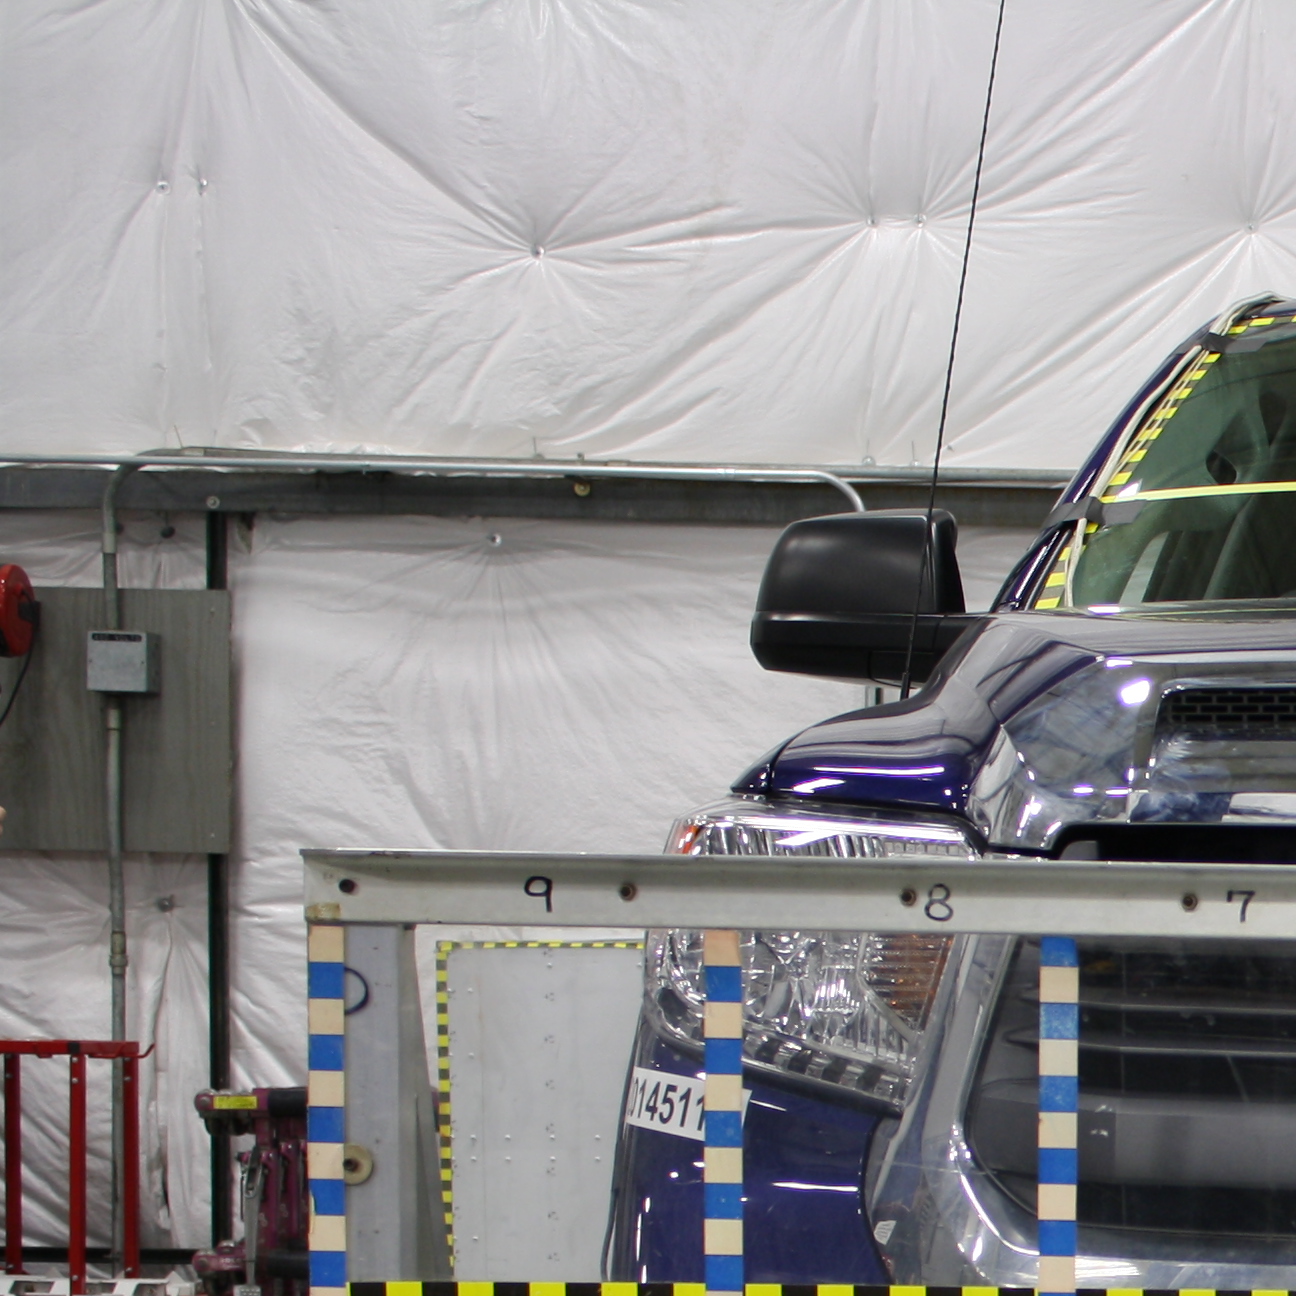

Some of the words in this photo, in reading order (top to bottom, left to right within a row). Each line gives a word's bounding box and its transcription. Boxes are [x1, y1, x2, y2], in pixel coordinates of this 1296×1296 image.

[523, 875, 553, 913] 9
[924, 883, 954, 921] 8
[1226, 890, 1257, 923] 7
